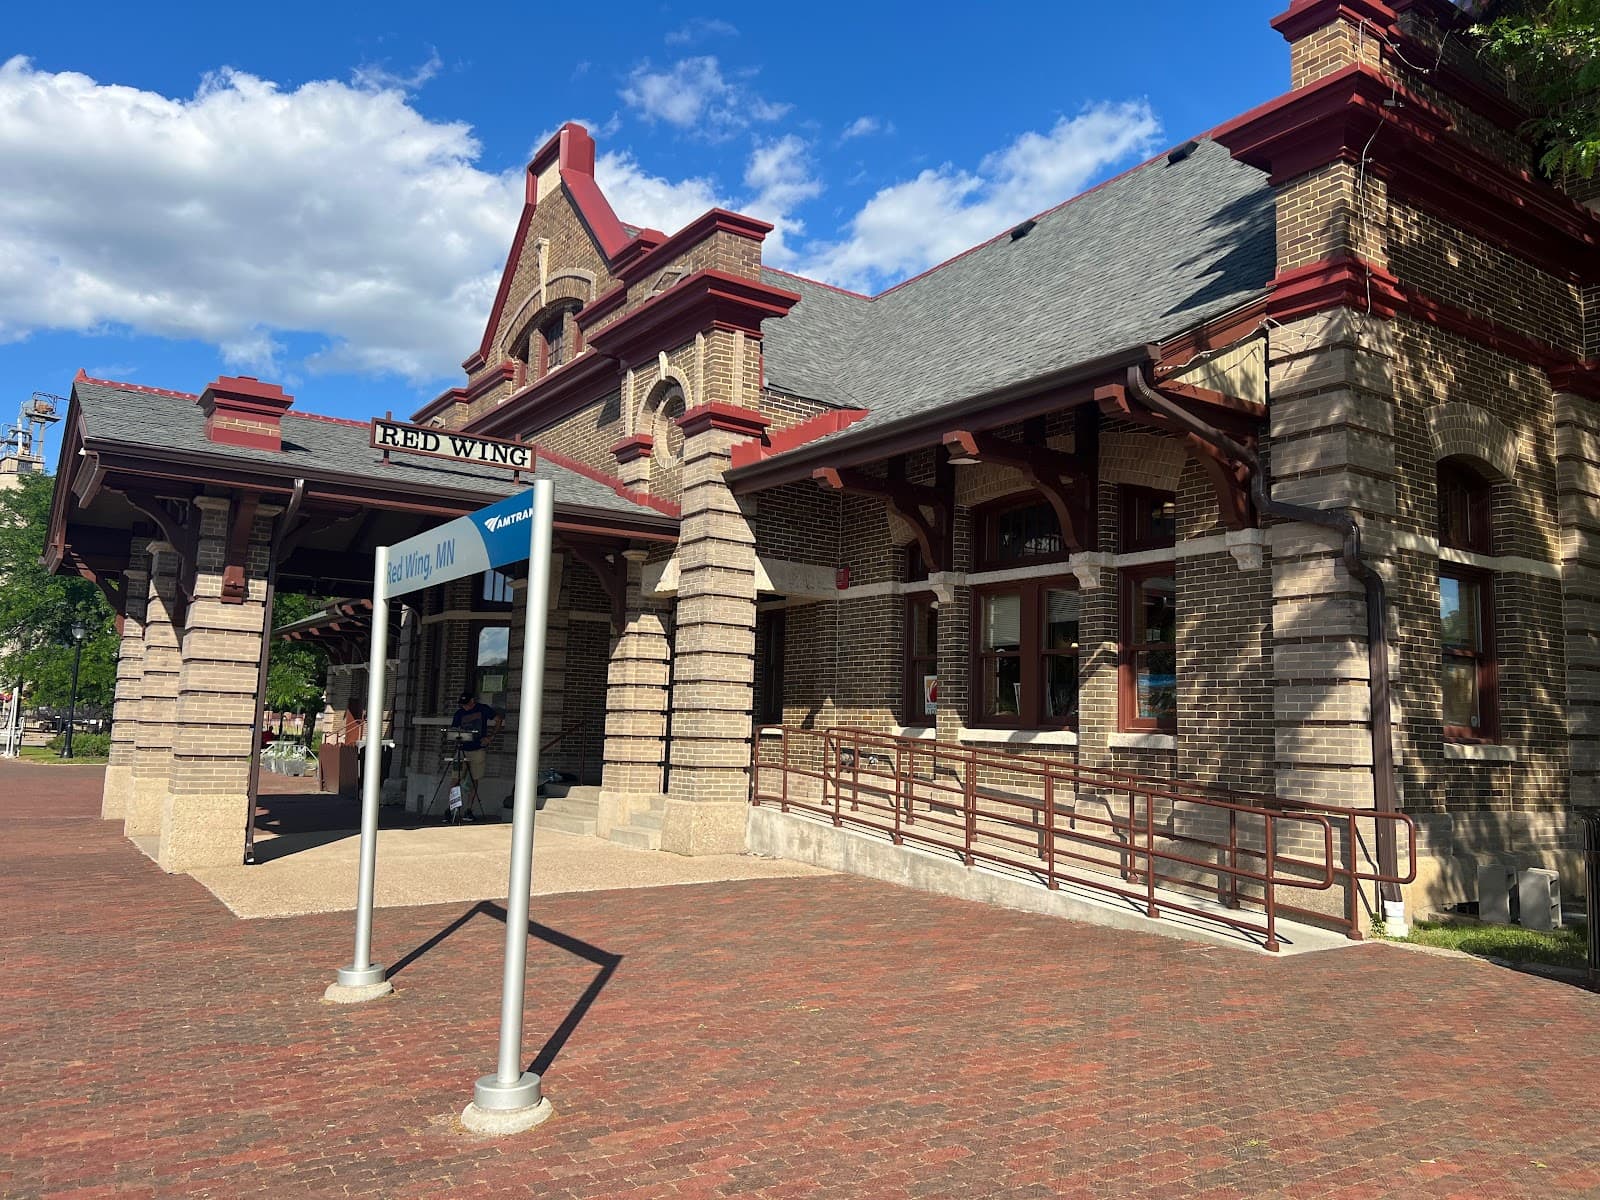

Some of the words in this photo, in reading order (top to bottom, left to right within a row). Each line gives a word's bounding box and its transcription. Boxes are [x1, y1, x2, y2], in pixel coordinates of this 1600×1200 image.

[379, 424, 440, 452] RED
[449, 436, 529, 467] WING
[386, 555, 403, 585] Red
[405, 550, 433, 580] Wing,
[436, 537, 455, 569] MN
